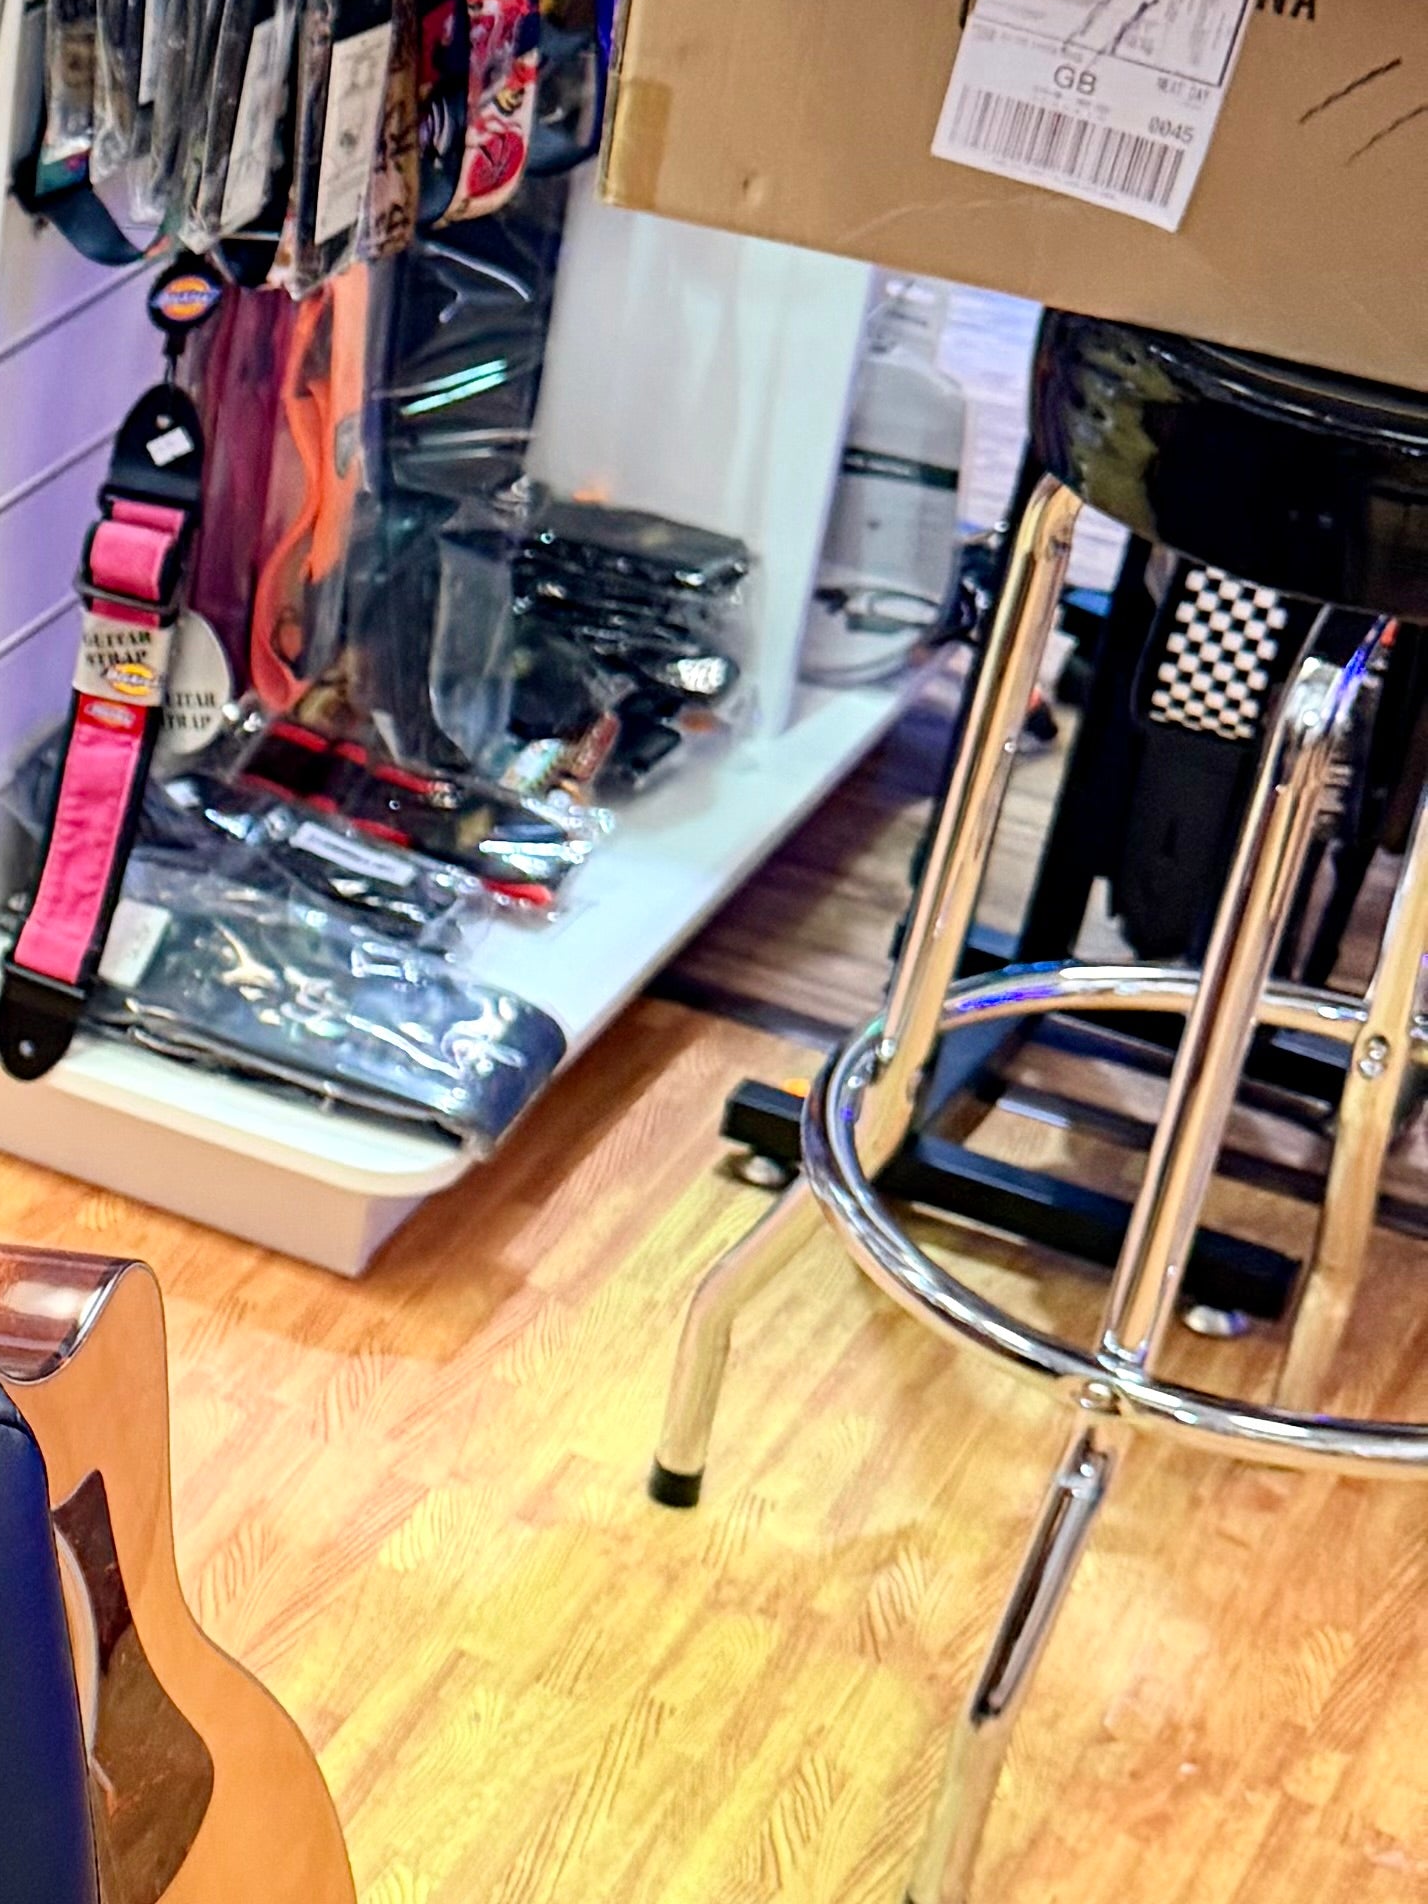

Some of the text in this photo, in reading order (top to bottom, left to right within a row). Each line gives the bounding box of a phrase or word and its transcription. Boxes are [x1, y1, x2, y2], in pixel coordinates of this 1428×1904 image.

[1053, 63, 1097, 96] GB
[1147, 116, 1196, 144] 0045
[86, 650, 147, 666] STRAP
